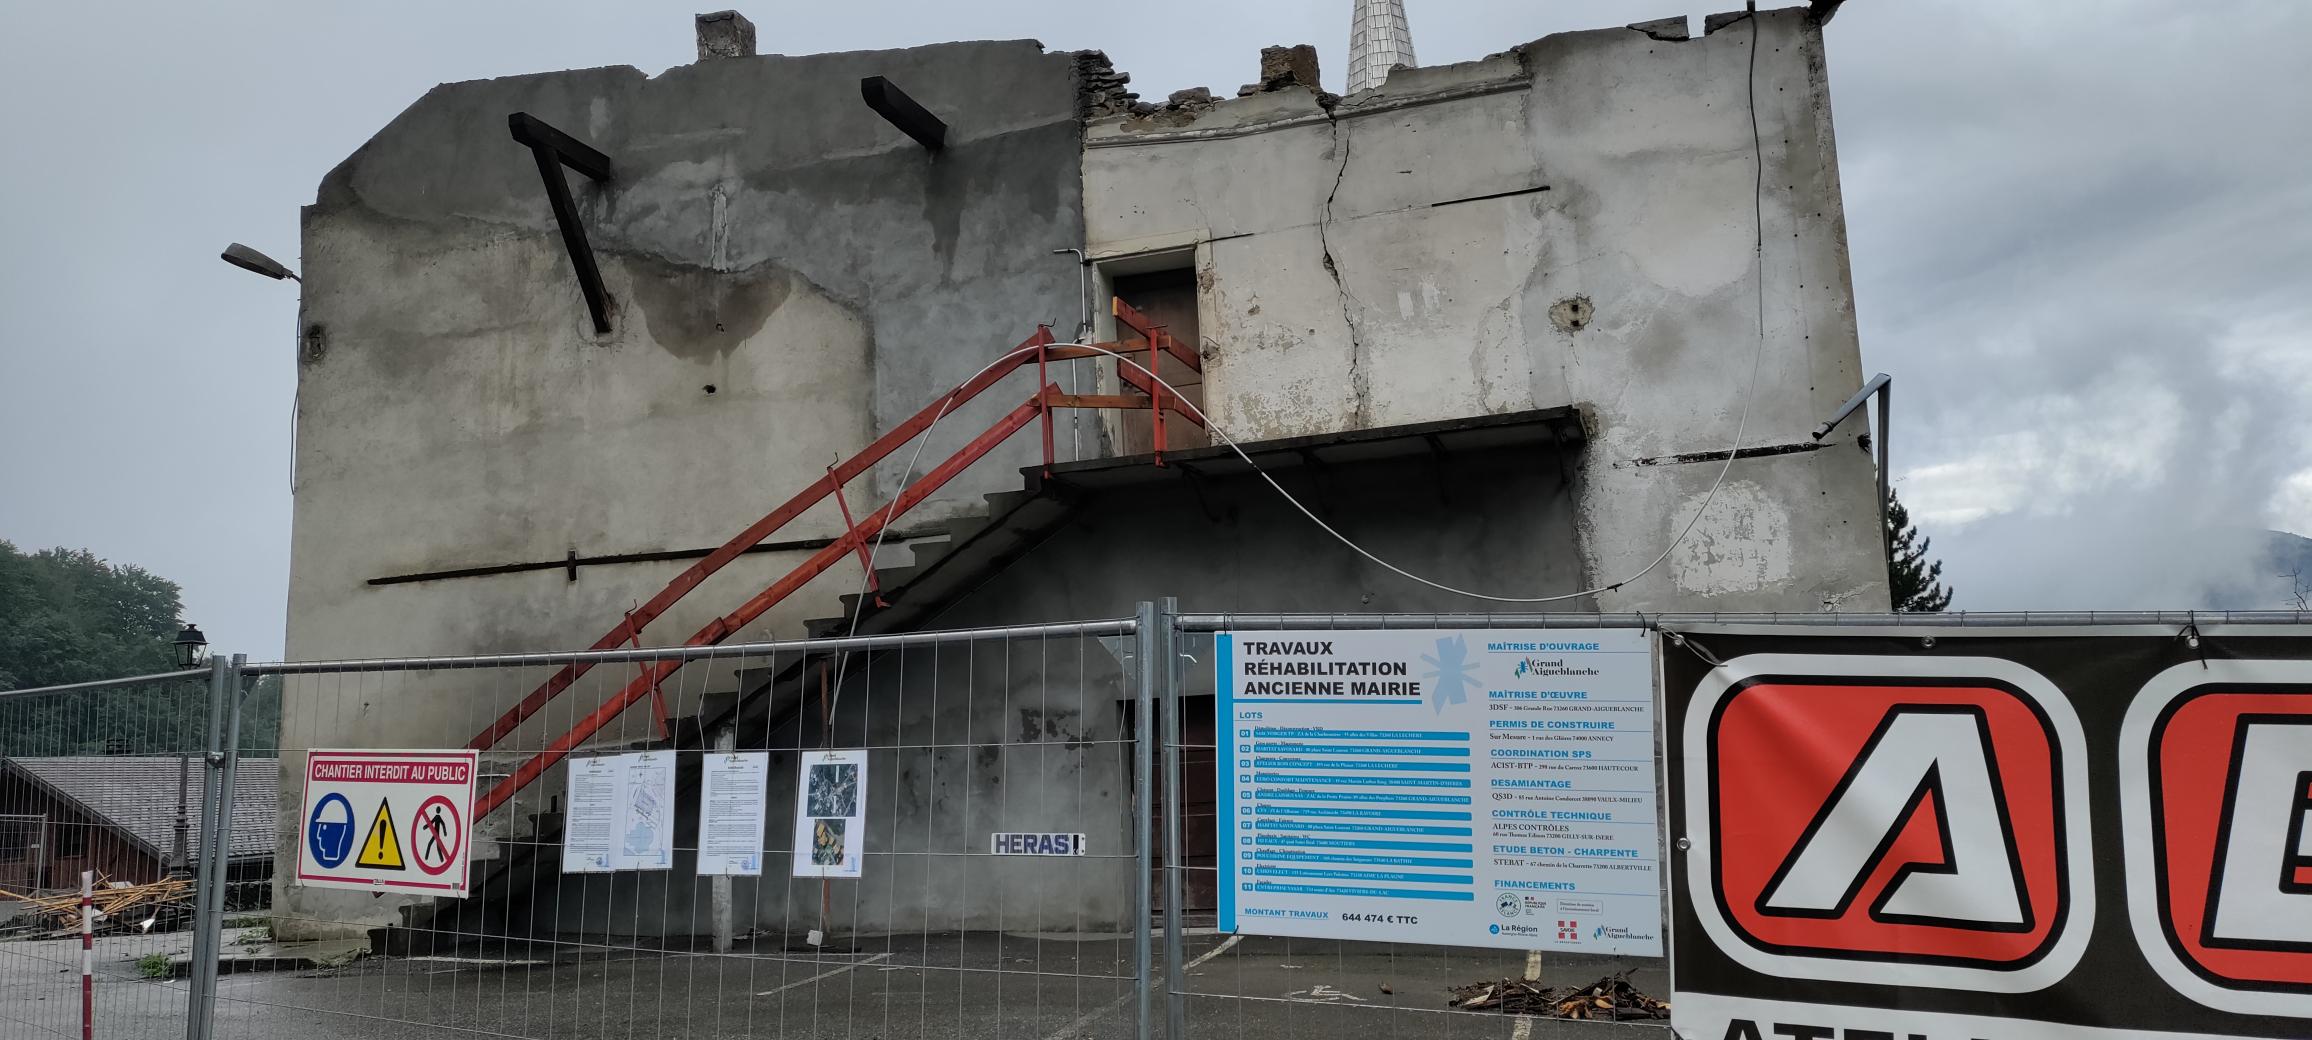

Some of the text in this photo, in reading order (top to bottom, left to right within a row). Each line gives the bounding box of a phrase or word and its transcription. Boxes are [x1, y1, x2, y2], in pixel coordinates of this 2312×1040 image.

[1243, 641, 1334, 655] TRAVAUX
[1488, 642, 1600, 651] MAÎTRISE D'OUVRAGE
[1244, 658, 1407, 676] RÉHABILITATION
[1532, 658, 1563, 667] Grand
[1532, 667, 1600, 677] Aigueblanche
[1244, 681, 1421, 696] ANCIENNE MAIRIE
[1488, 690, 1537, 699] MAÎTRISE
[1547, 721, 1615, 729] CONSTRUIRE
[1491, 749, 1592, 758] COORDINATION SPS
[314, 764, 466, 781] CHANTIER INTERDIT AU PUBLIC
[1491, 779, 1572, 788] DESAMIANTAGE
[1492, 809, 1612, 820] CONTRÔLE TECHNIQUE
[1519, 823, 1569, 832] CONTRÔLES
[996, 834, 1069, 854] HERAS
[1493, 845, 1526, 853] ETUDE
[1530, 846, 1564, 855] BETON
[1574, 848, 1638, 857] CHARPENTE
[1494, 880, 1576, 890] FINANCEMENTS
[1244, 908, 1328, 919] MONTANT TRAVAUX
[1342, 913, 1361, 921] 644
[1364, 914, 1384, 923] 474
[1397, 916, 1418, 924] TTC
[1512, 925, 1538, 933] Région
